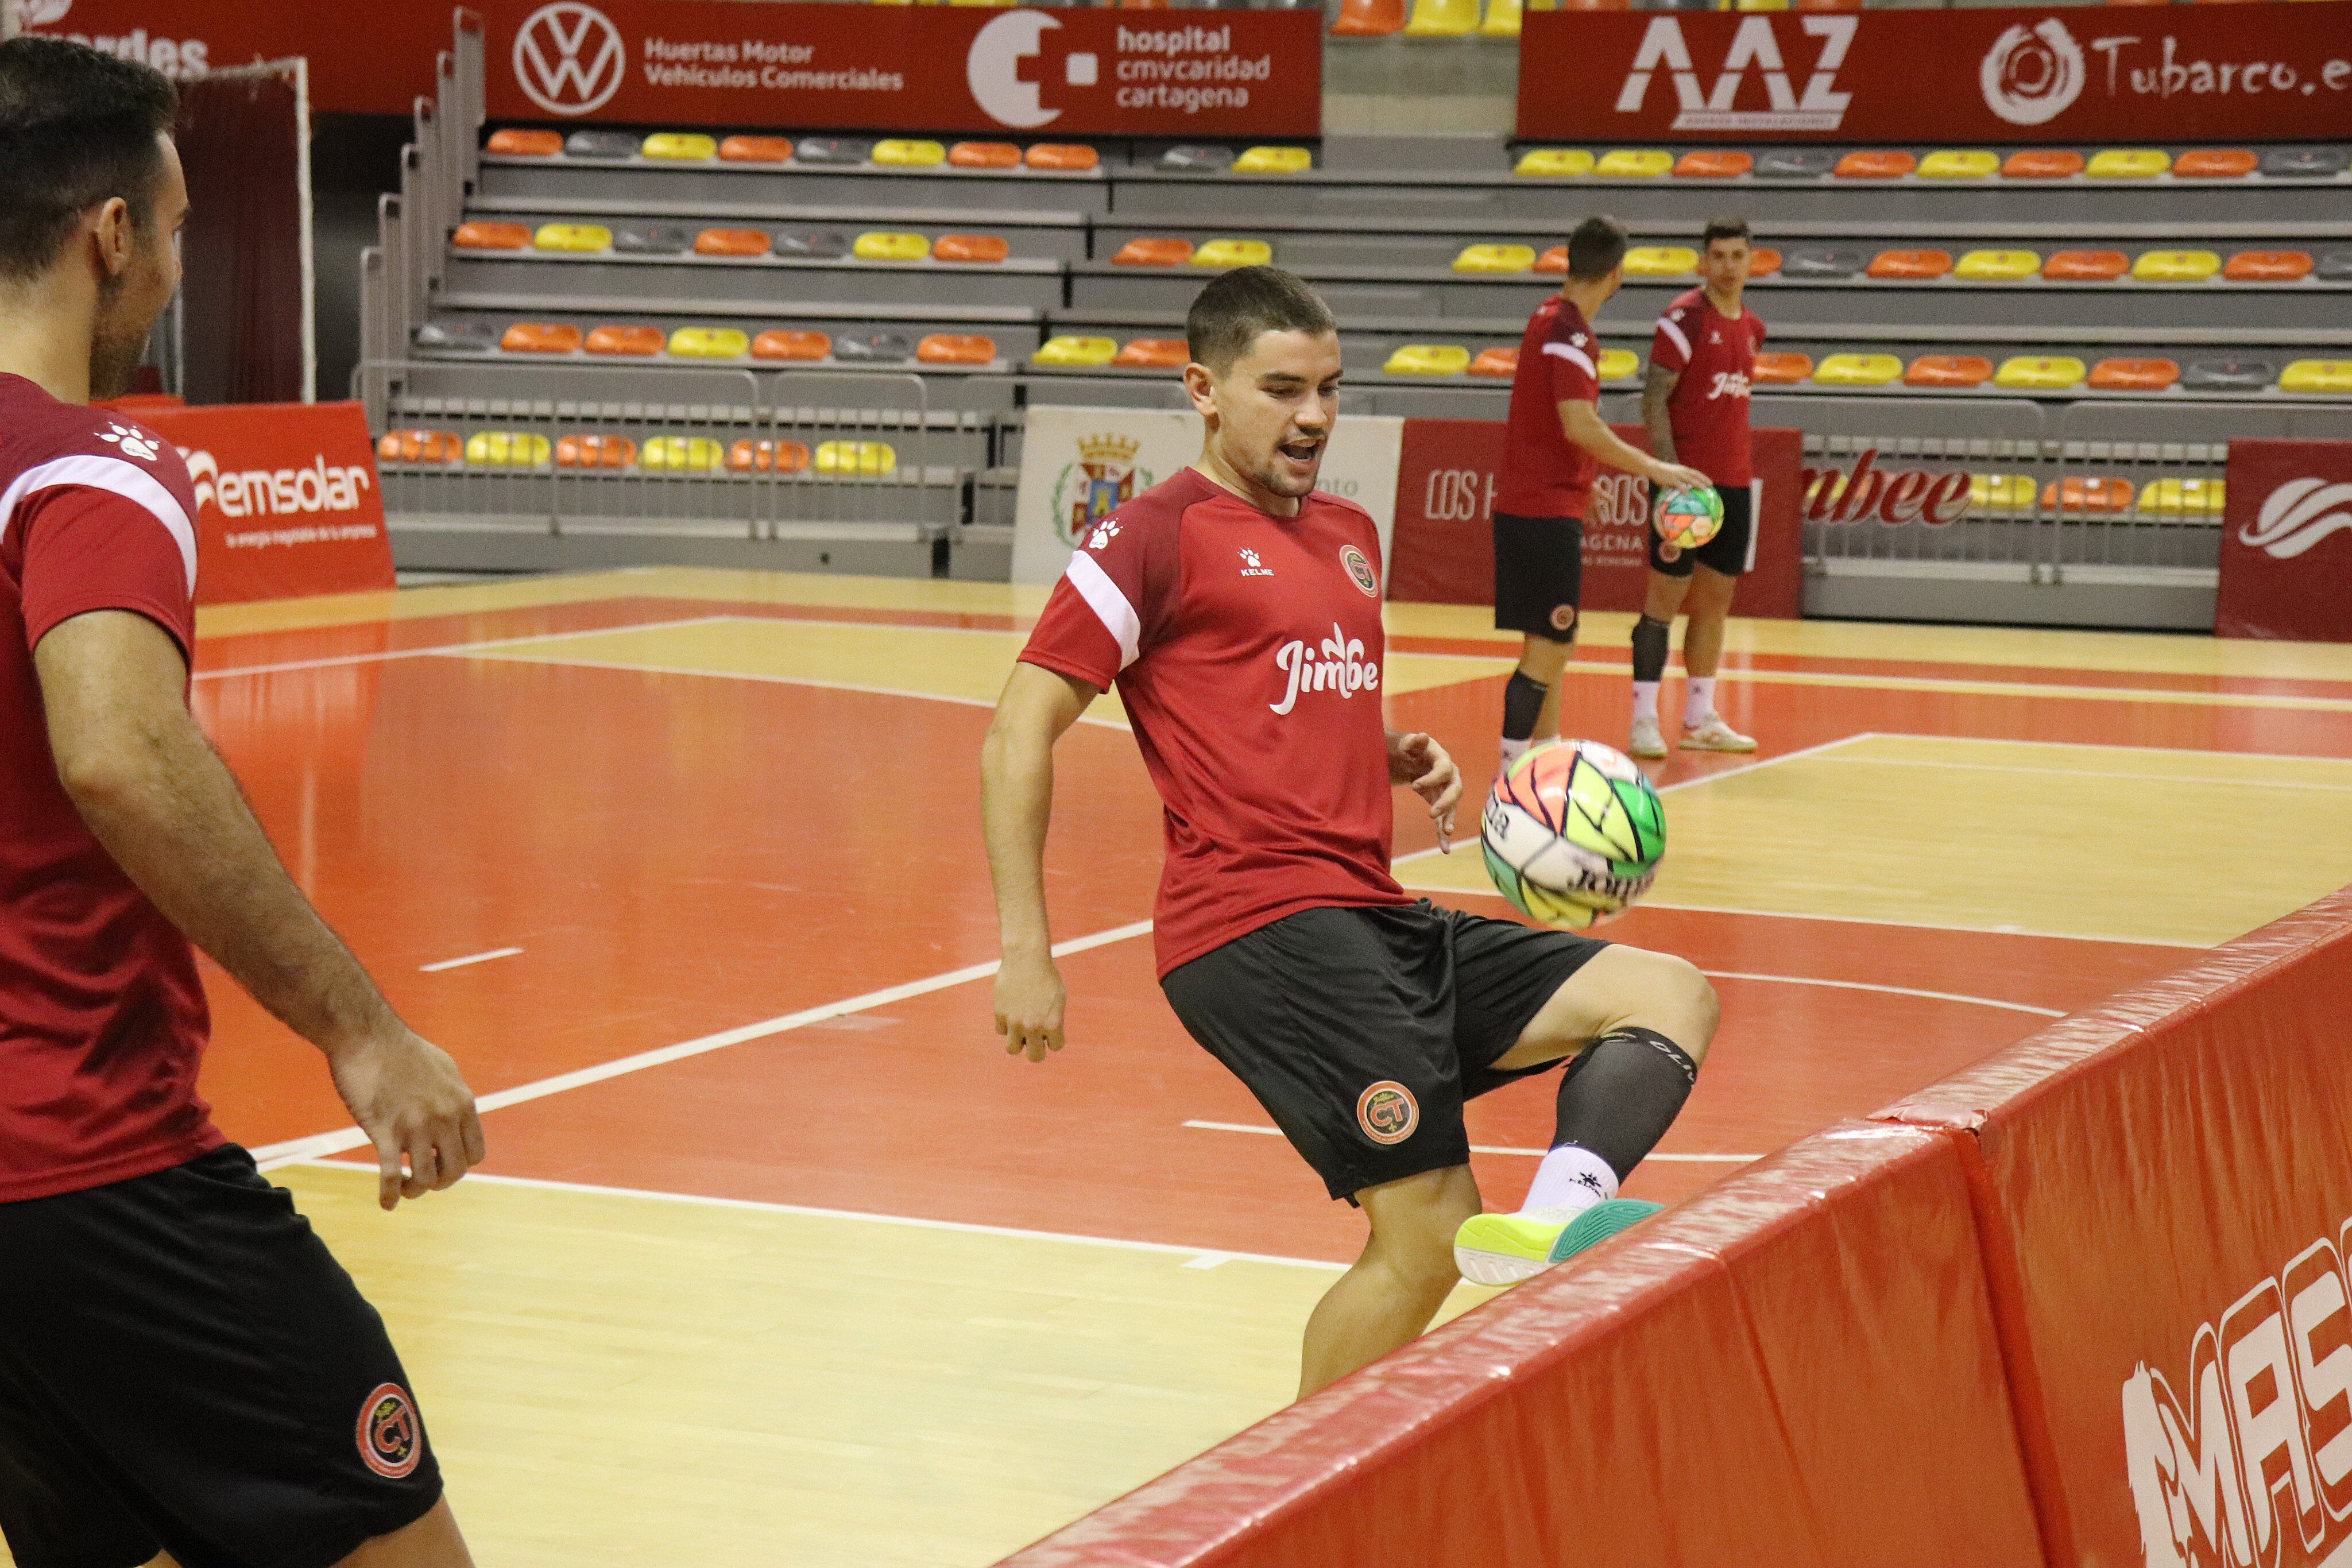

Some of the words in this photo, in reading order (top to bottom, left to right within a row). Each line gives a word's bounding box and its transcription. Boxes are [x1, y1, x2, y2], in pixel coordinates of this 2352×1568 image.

[644, 36, 738, 62] Huertas
[742, 39, 814, 64] Motor
[1117, 25, 1231, 56] hospital
[761, 65, 904, 91] Comerciales
[1117, 55, 1271, 82] cmvcaridad
[1117, 82, 1250, 114] cartagena
[1425, 469, 1478, 521] LOS
[1240, 568, 1275, 577] KELME
[1269, 621, 1379, 715] Jimbe
[1371, 1098, 1405, 1127] CT
[2122, 1216, 2352, 1568] MAS
[374, 1406, 410, 1453] CT
